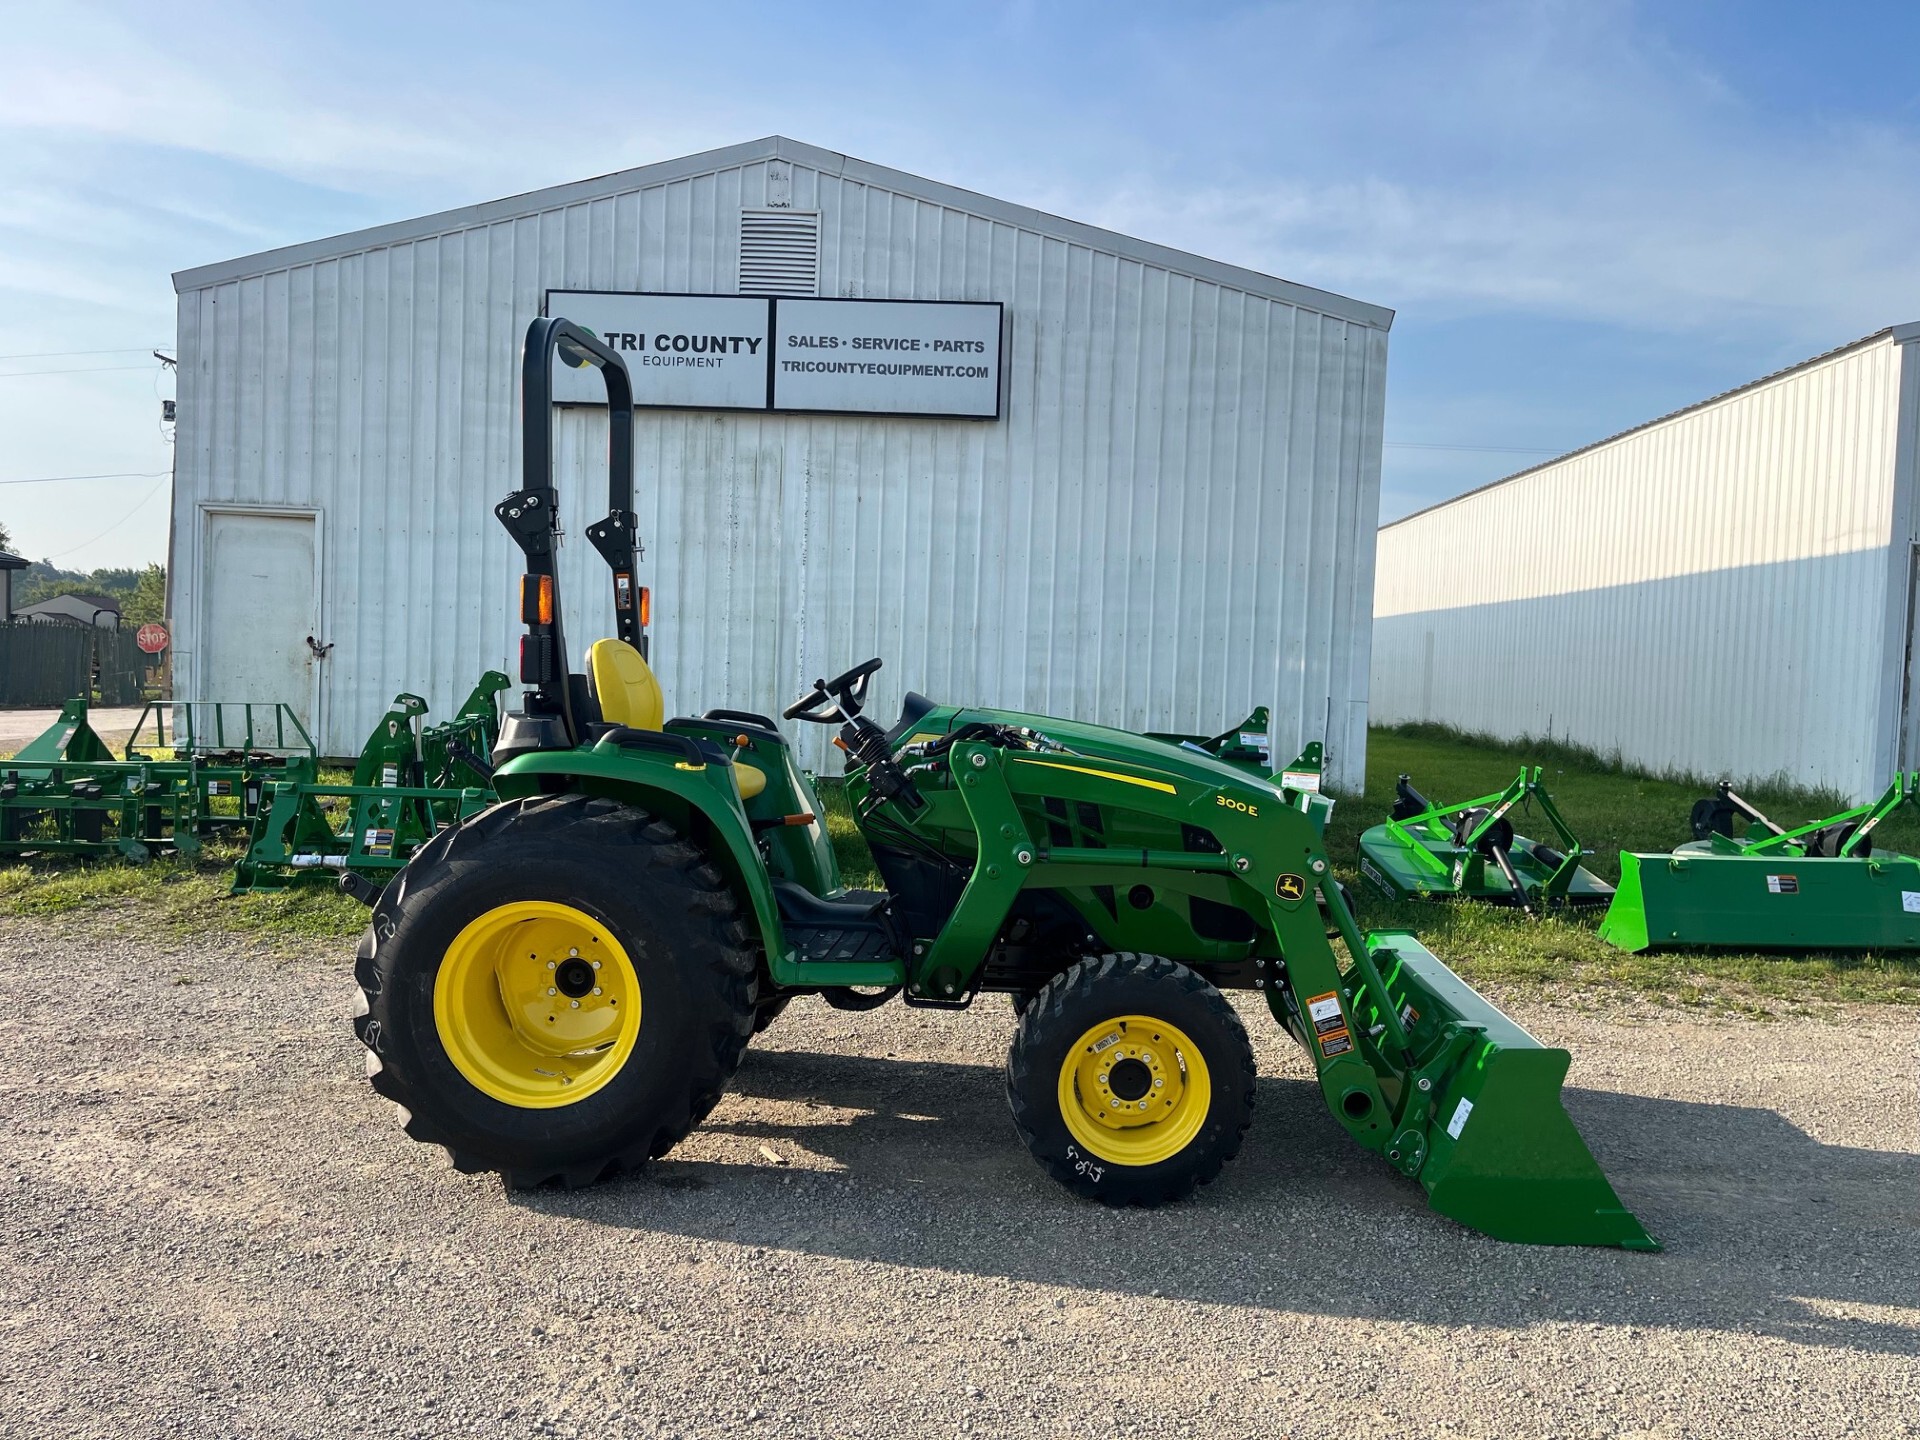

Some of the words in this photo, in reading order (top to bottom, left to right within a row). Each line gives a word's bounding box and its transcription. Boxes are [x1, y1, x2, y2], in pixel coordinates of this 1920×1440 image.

[604, 333, 645, 351] TRI
[654, 334, 763, 355] COUNTY
[787, 335, 839, 349] SALES
[851, 337, 921, 351] SERVICE
[933, 340, 985, 353] PARTS
[643, 355, 724, 368] EQUIPMENT
[782, 360, 989, 378] TRICOUNTYEQUIPMENT.COM
[139, 632, 166, 645] STOP
